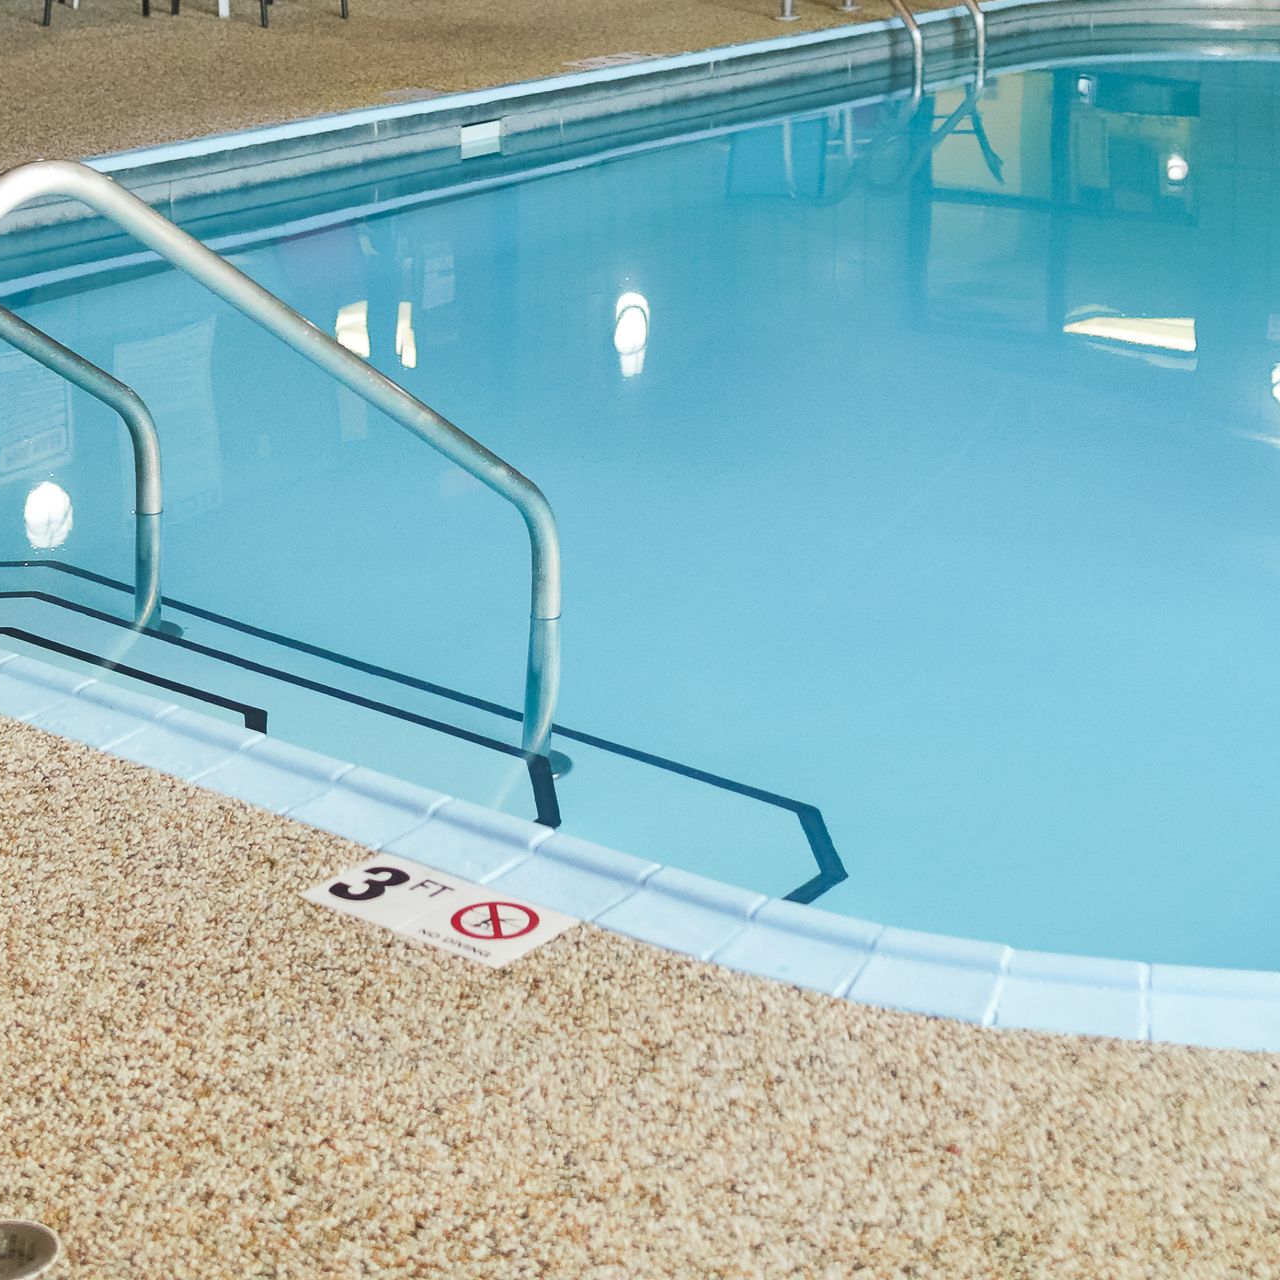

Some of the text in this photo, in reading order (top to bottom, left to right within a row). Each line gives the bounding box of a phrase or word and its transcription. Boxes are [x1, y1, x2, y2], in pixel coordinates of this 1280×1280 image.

[328, 866, 456, 901] 3 FT
[418, 928, 493, 958] NO DIVING
